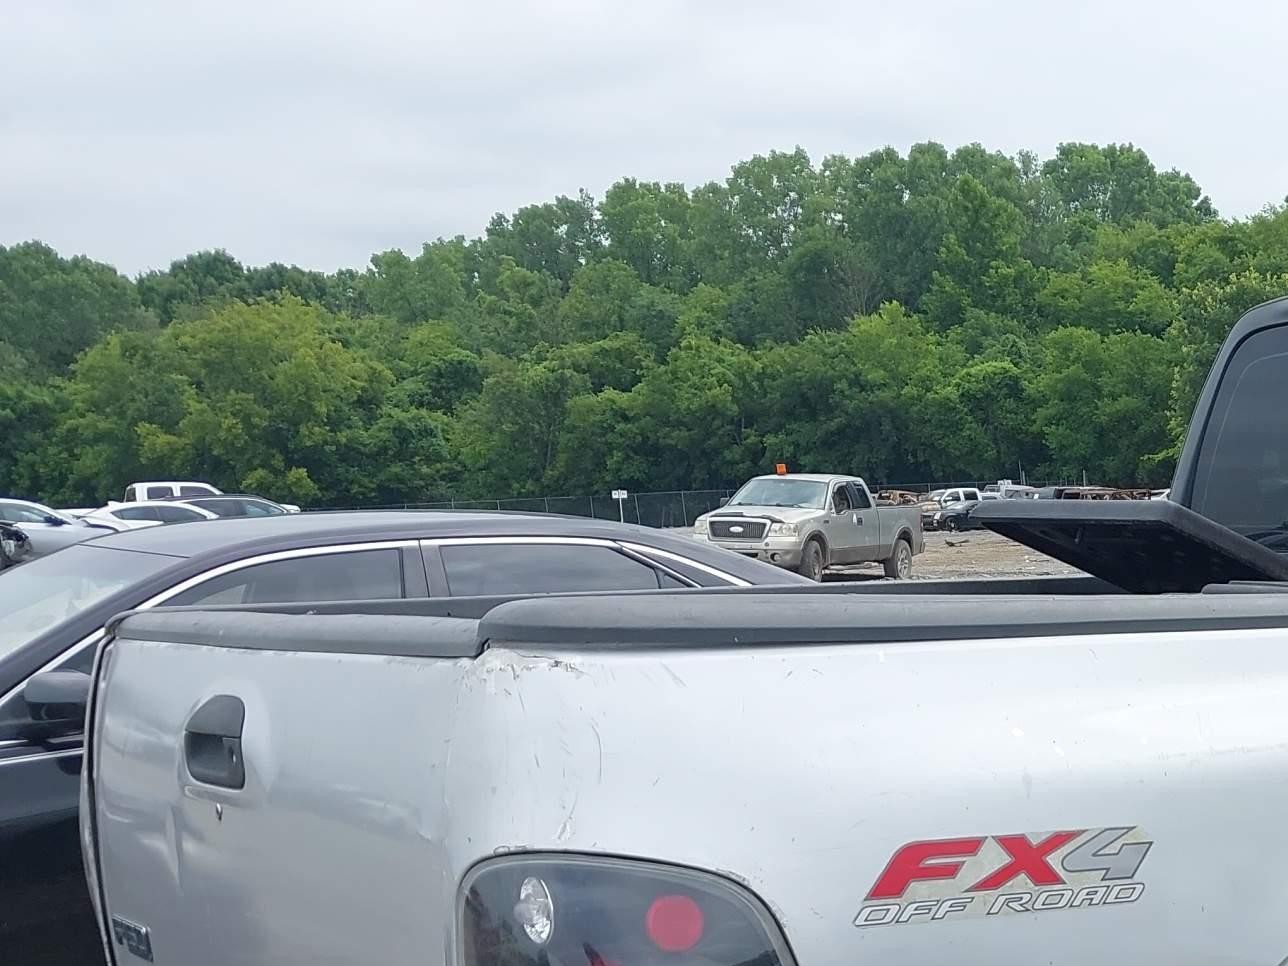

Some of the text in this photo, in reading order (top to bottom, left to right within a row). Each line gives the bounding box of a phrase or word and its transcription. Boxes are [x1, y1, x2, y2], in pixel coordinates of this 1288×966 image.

[863, 825, 1154, 901] FX4
[853, 882, 1146, 928] OFF ROAD
